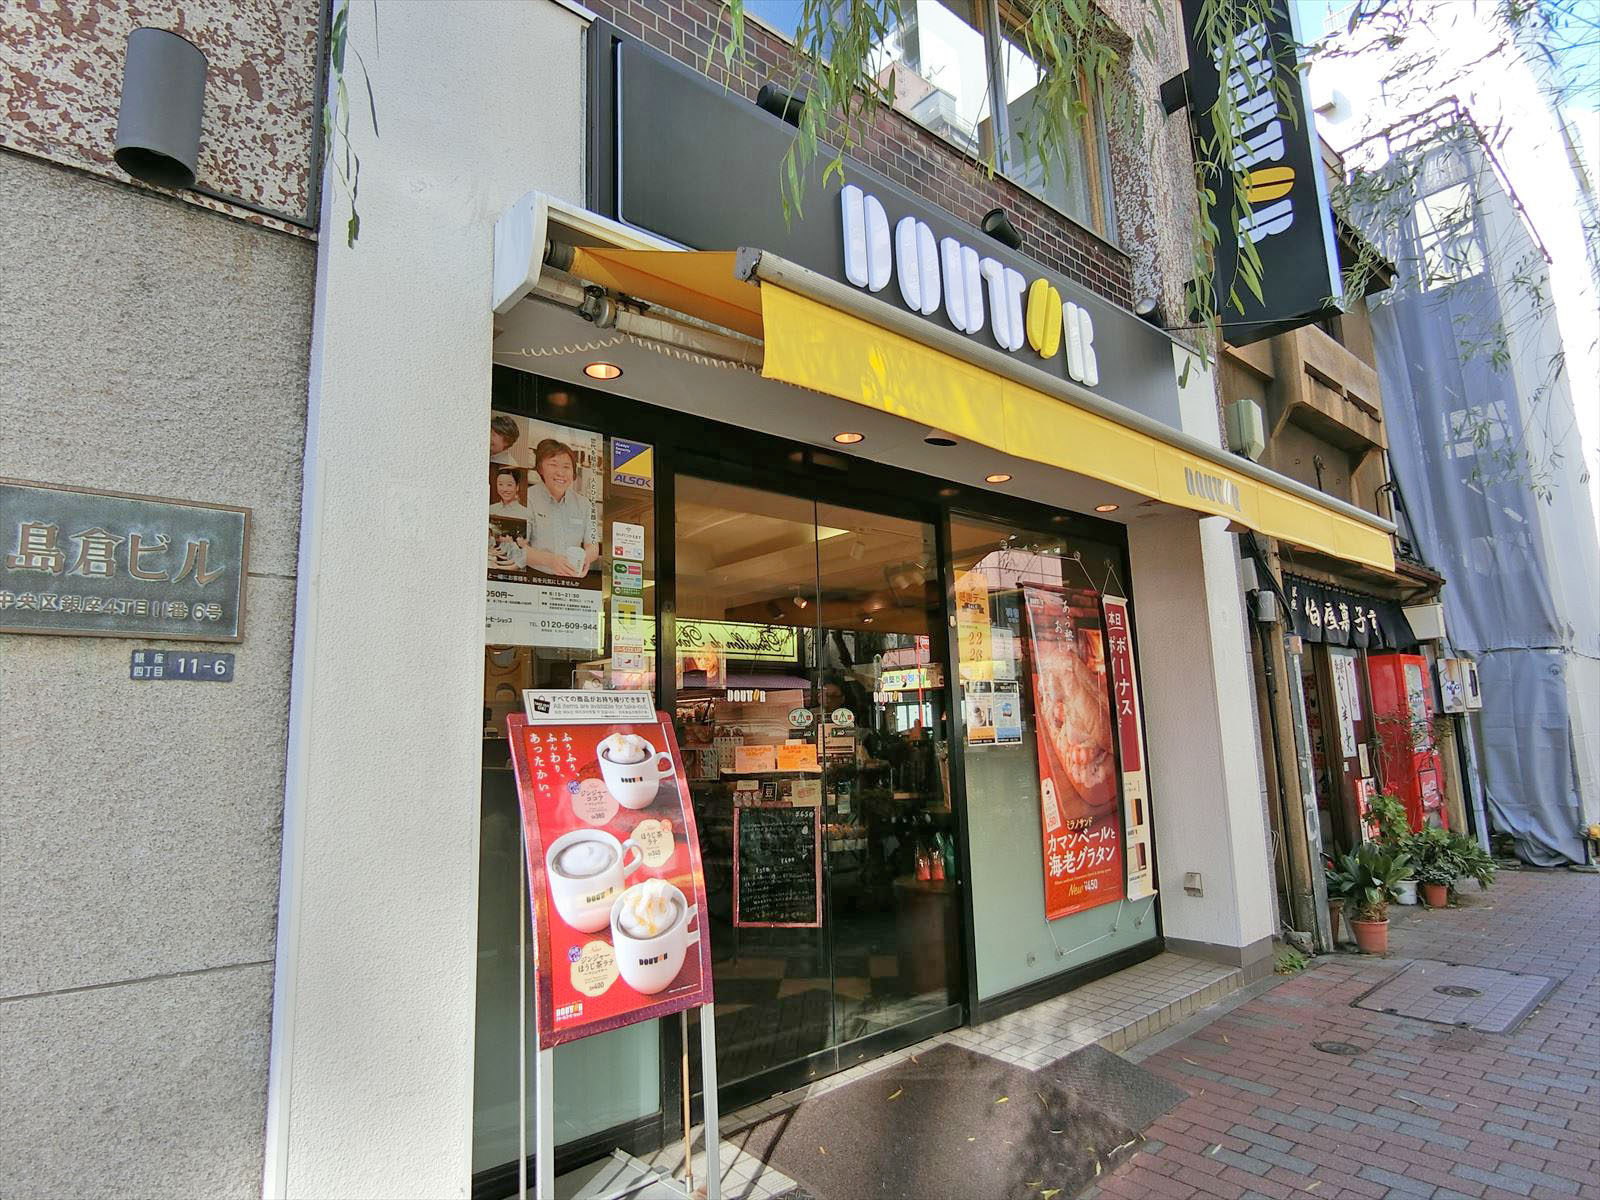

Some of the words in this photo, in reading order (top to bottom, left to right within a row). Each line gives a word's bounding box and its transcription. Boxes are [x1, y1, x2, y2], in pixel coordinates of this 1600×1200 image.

[841, 184, 1098, 387] DOUTOR
[613, 474, 652, 488] ALSOK
[1184, 467, 1241, 513] DOUTOR
[6, 521, 225, 585] 島倉ビル
[540, 620, 598, 630] 0120-609-944
[133, 666, 164, 677] 四丁目
[178, 658, 226, 675] 11-6
[727, 690, 767, 703] DOUTOR
[1066, 816, 1093, 830] ミラノサンド
[1047, 826, 1116, 855] カマンベールと
[1048, 846, 1116, 877] 海老グラタン
